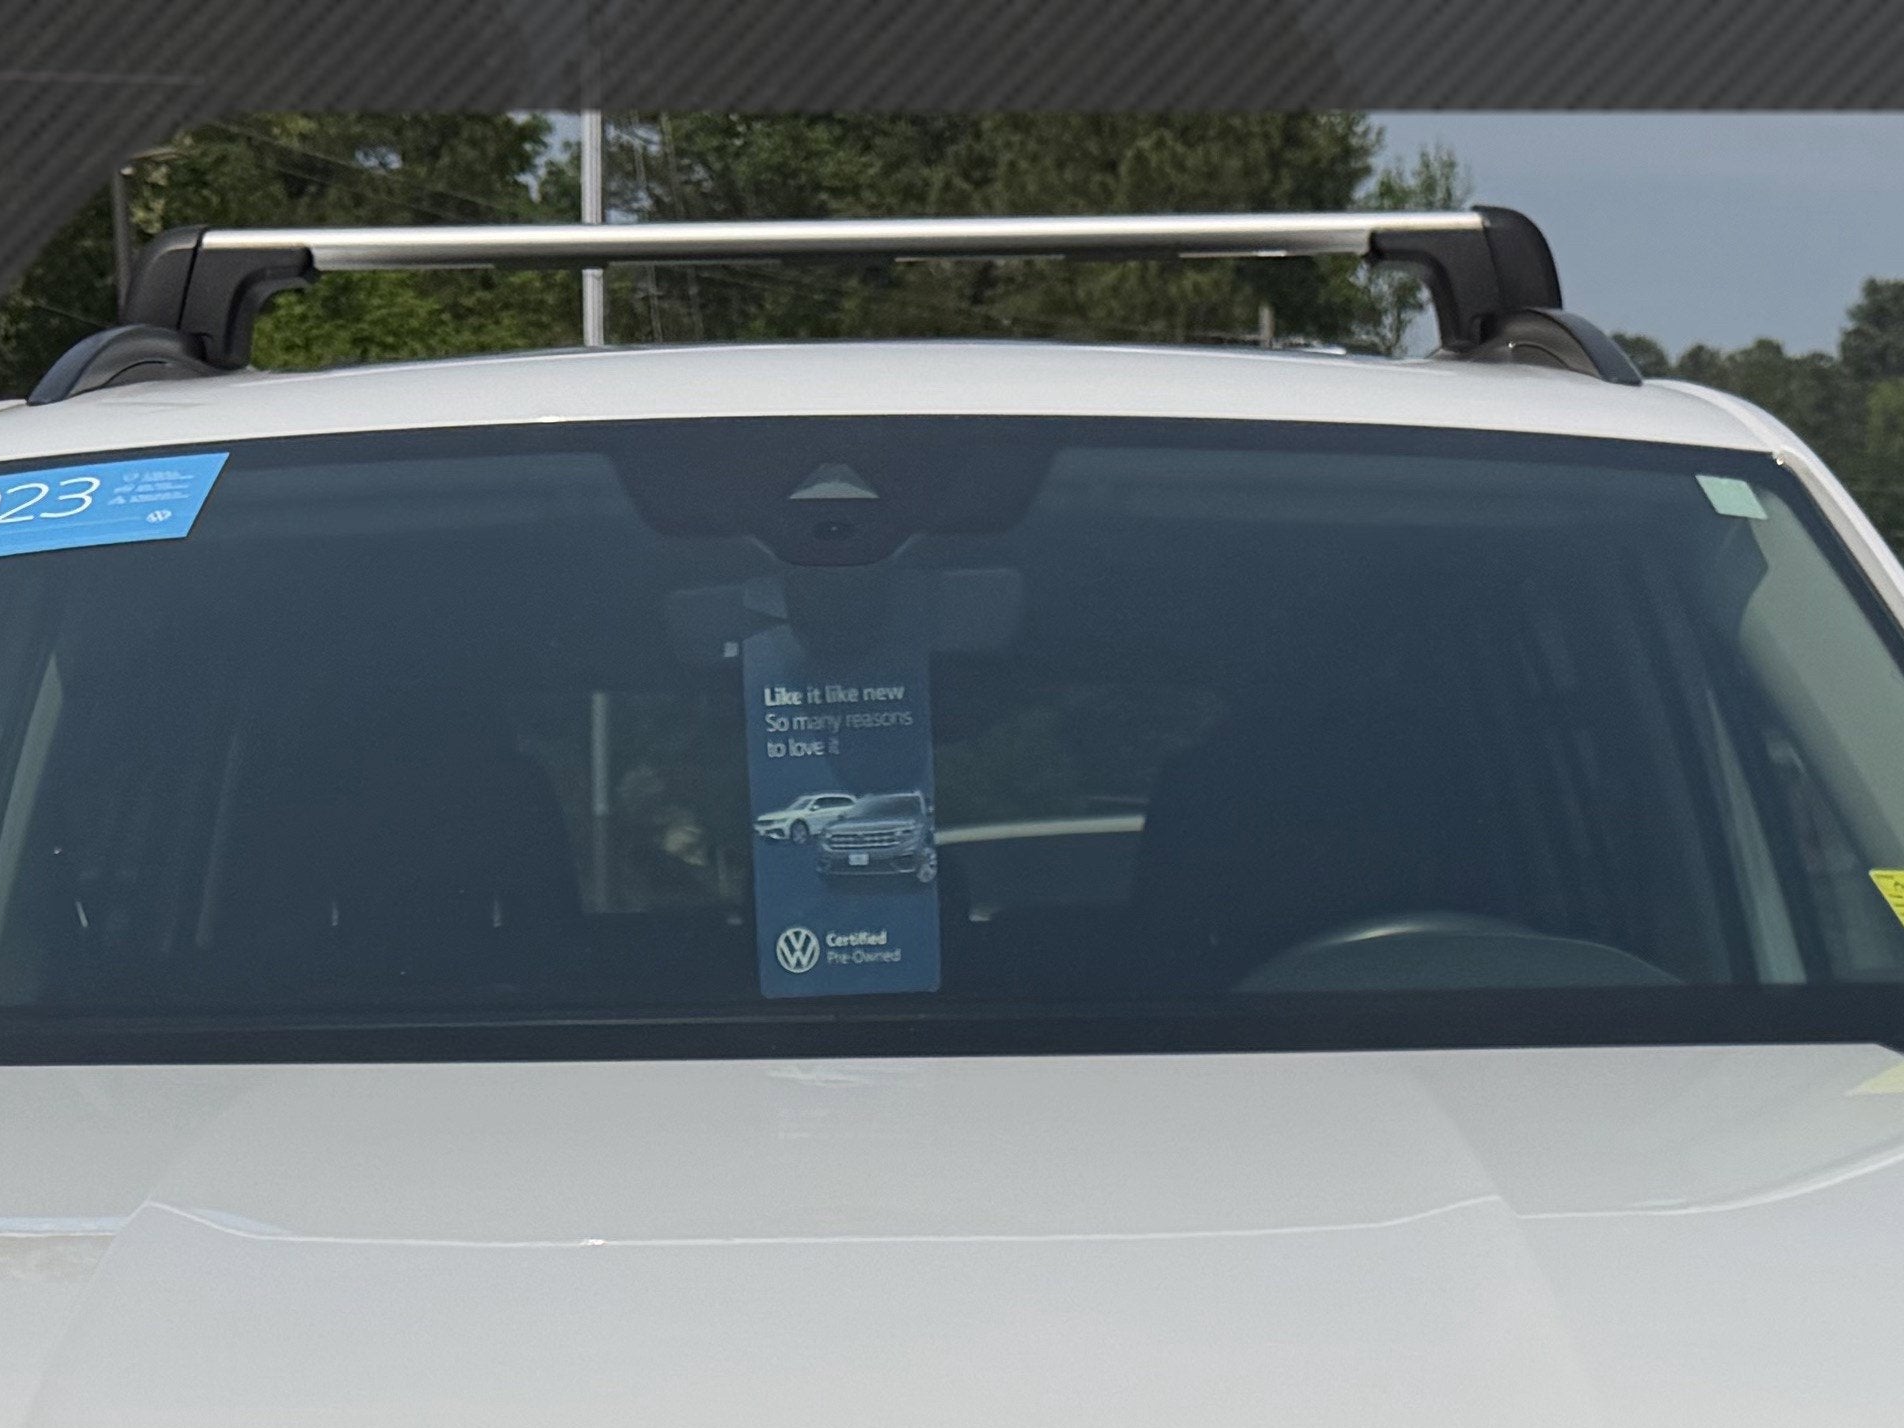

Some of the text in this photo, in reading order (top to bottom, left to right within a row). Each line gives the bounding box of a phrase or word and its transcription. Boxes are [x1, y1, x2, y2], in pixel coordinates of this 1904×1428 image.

[764, 685, 905, 706] Like it like new
[765, 711, 913, 733] So many reasons
[767, 741, 786, 757] to
[789, 738, 824, 755] love
[826, 930, 887, 947] Certified
[827, 949, 901, 963] Pre-Owned
